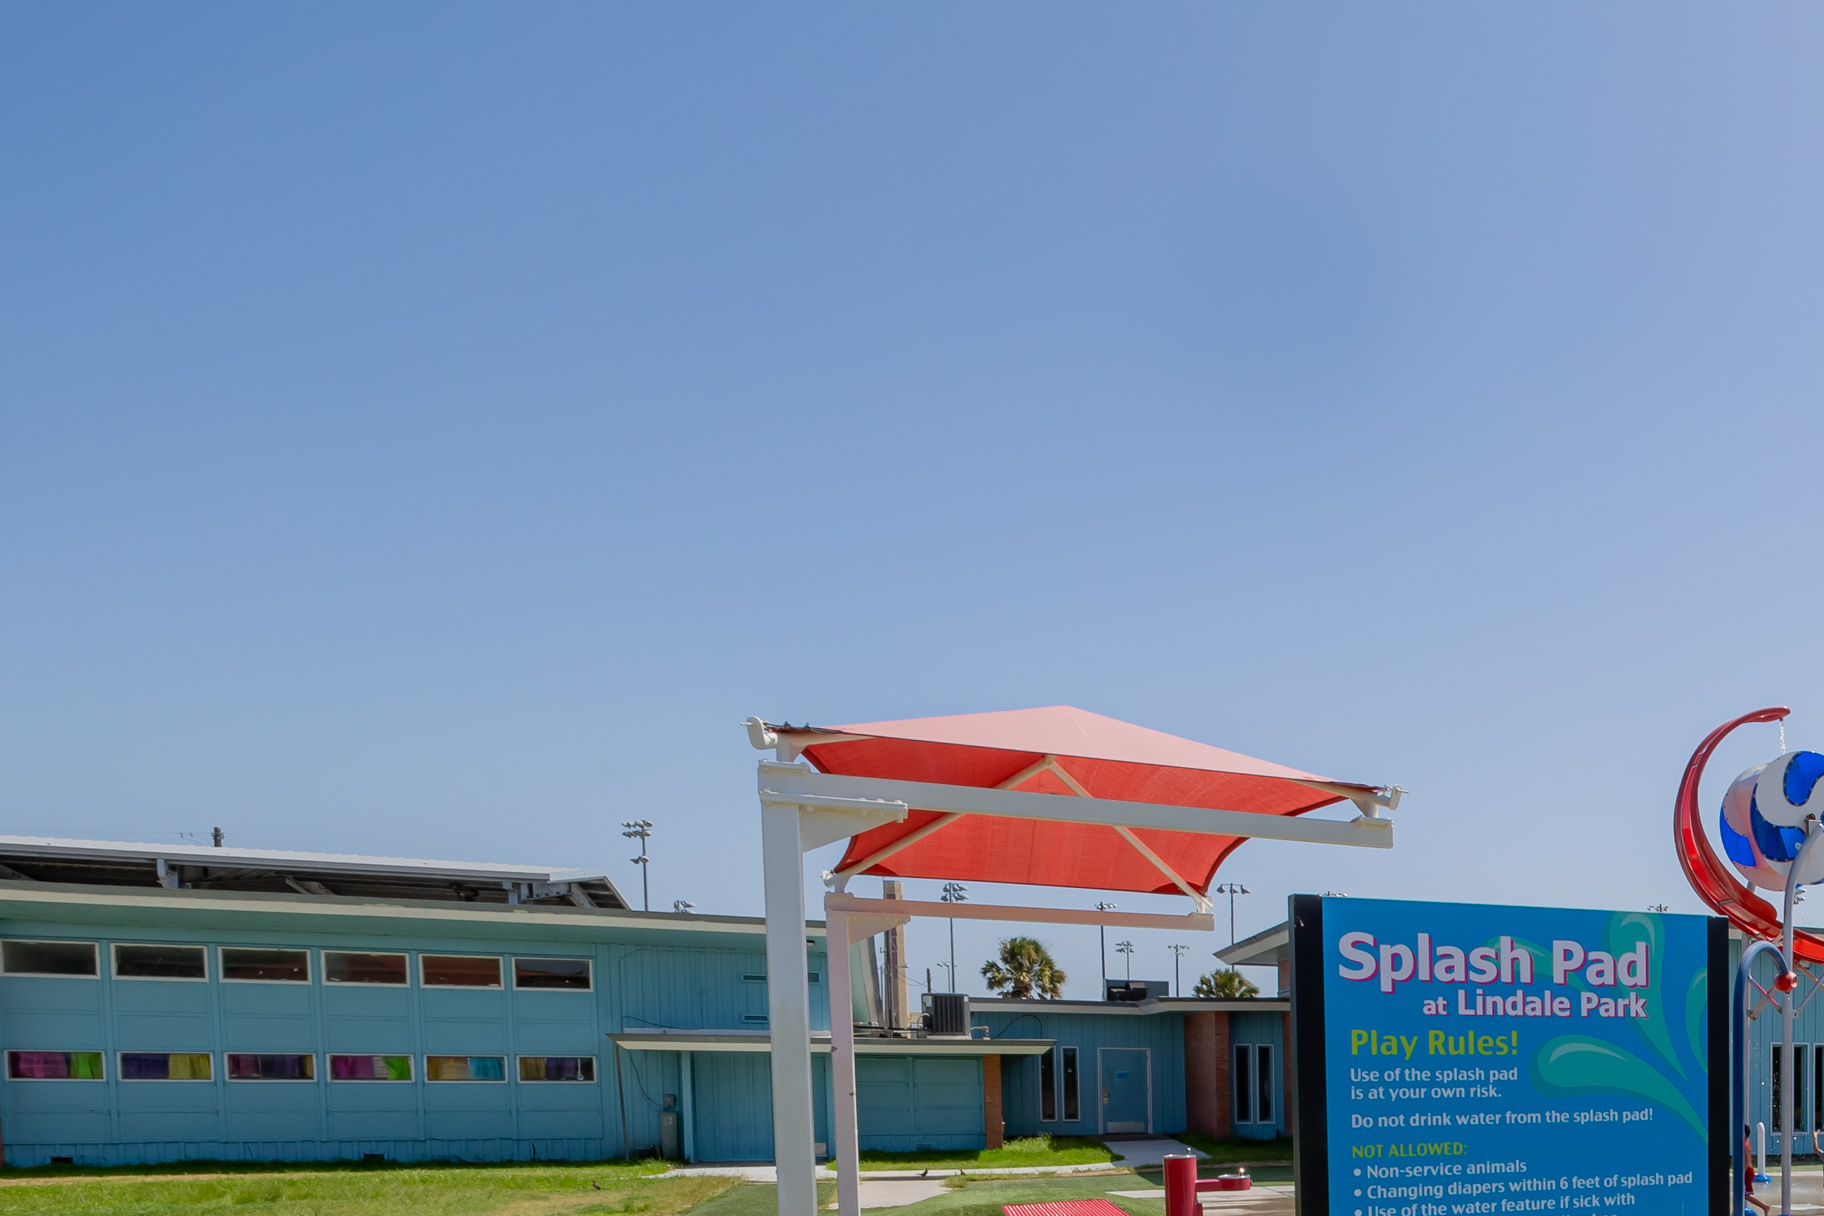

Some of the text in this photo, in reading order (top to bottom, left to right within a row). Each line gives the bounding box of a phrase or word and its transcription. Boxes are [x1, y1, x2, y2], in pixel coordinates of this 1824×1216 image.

[1338, 931, 1650, 994] Splash Pad
[1422, 989, 1647, 1018] at Lindale Park
[1350, 1029, 1519, 1062] Play Rules!
[1350, 1066, 1517, 1085] Use of the splash pad
[1351, 1083, 1502, 1102] is at your own risk.
[1351, 1107, 1652, 1128] Do not drink water from the splash pad!
[1352, 1140, 1468, 1159] NOT ALLOWED:
[1367, 1159, 1527, 1179] Non-service animals
[1367, 1170, 1692, 1201] Changing diapers within 6 feet of splash pad
[1420, 1202, 1447, 1216] the
[1451, 1201, 1497, 1215] water
[1501, 1198, 1555, 1212] feature
[1560, 1194, 1569, 1209] if
[1572, 1193, 1600, 1208] sick
[1603, 1191, 1635, 1206] with
